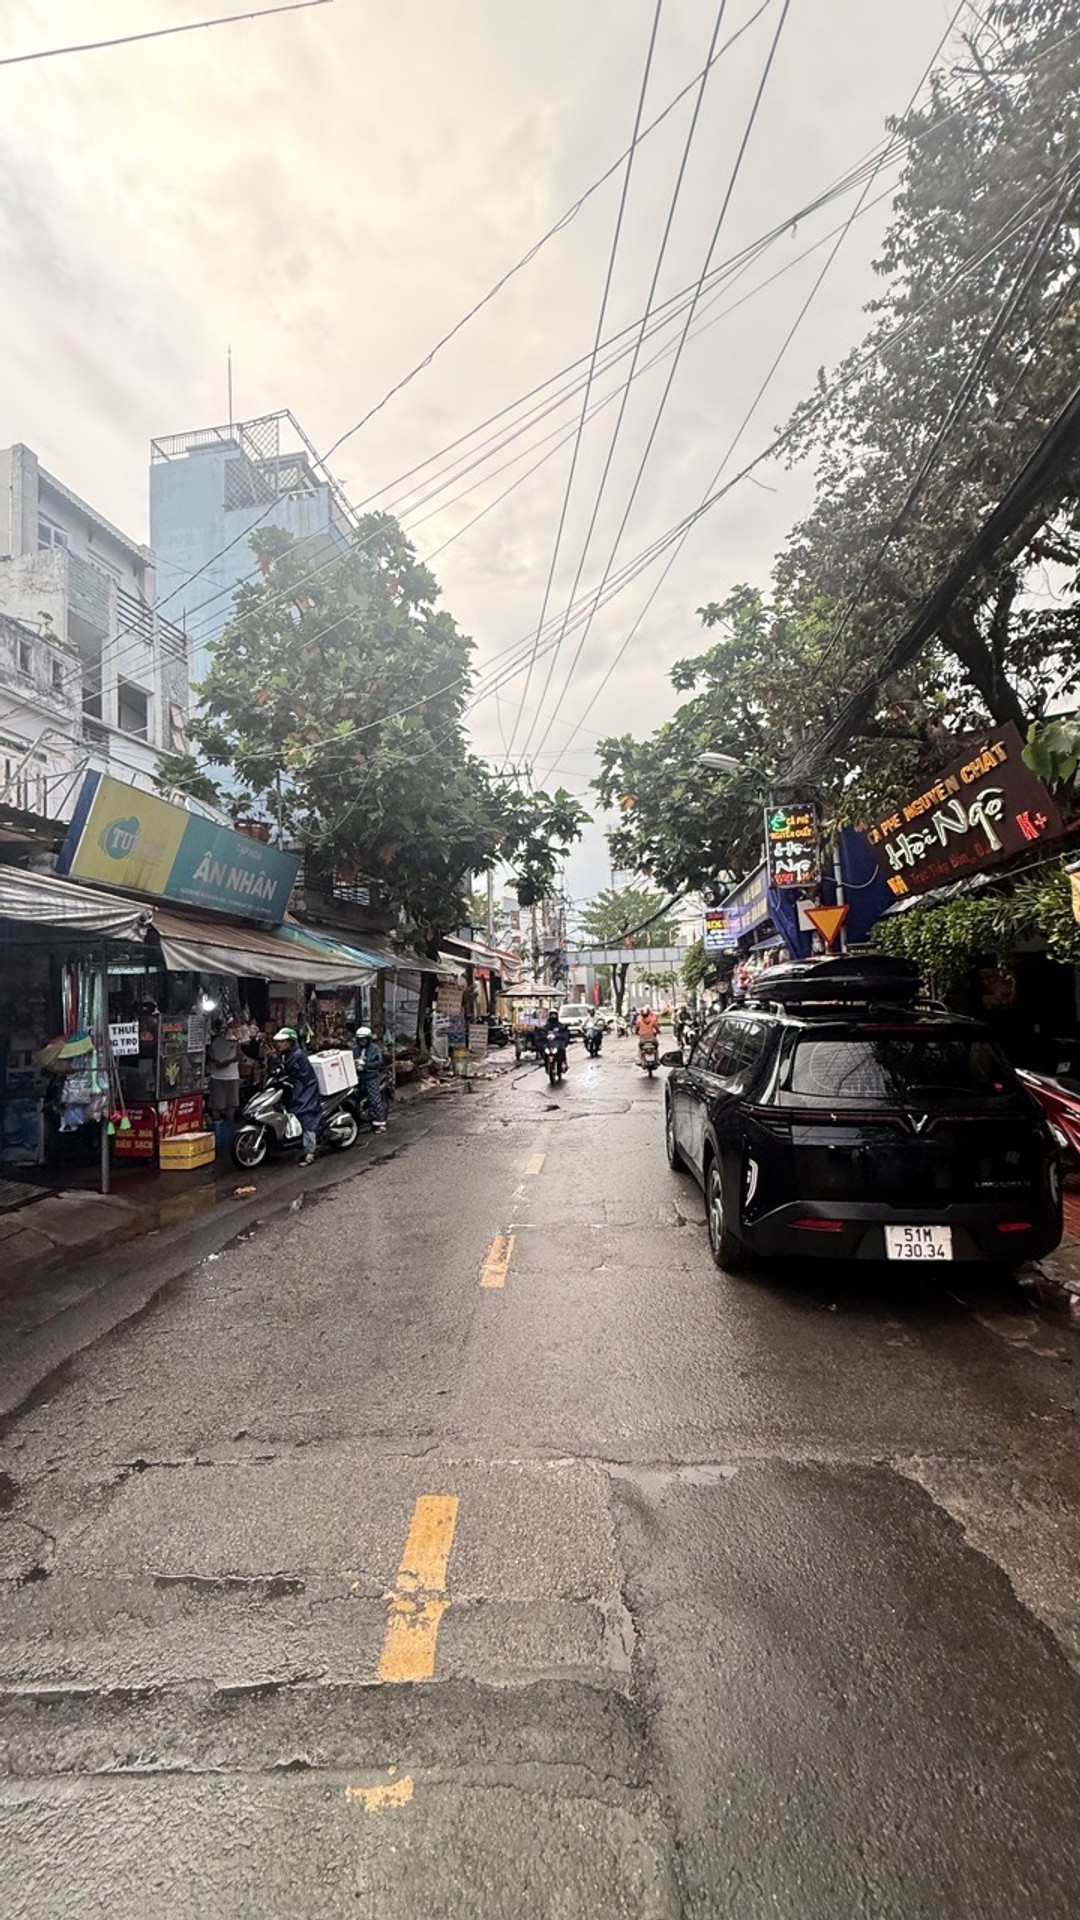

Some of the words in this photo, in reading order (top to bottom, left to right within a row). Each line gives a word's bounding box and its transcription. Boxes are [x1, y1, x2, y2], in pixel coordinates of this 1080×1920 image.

[902, 774, 961, 822] NGUYÊN
[1015, 811, 1047, 841] K+
[192, 850, 227, 886] ÂN
[226, 867, 278, 901] NHÂN
[895, 1243, 945, 1258] 730.34
